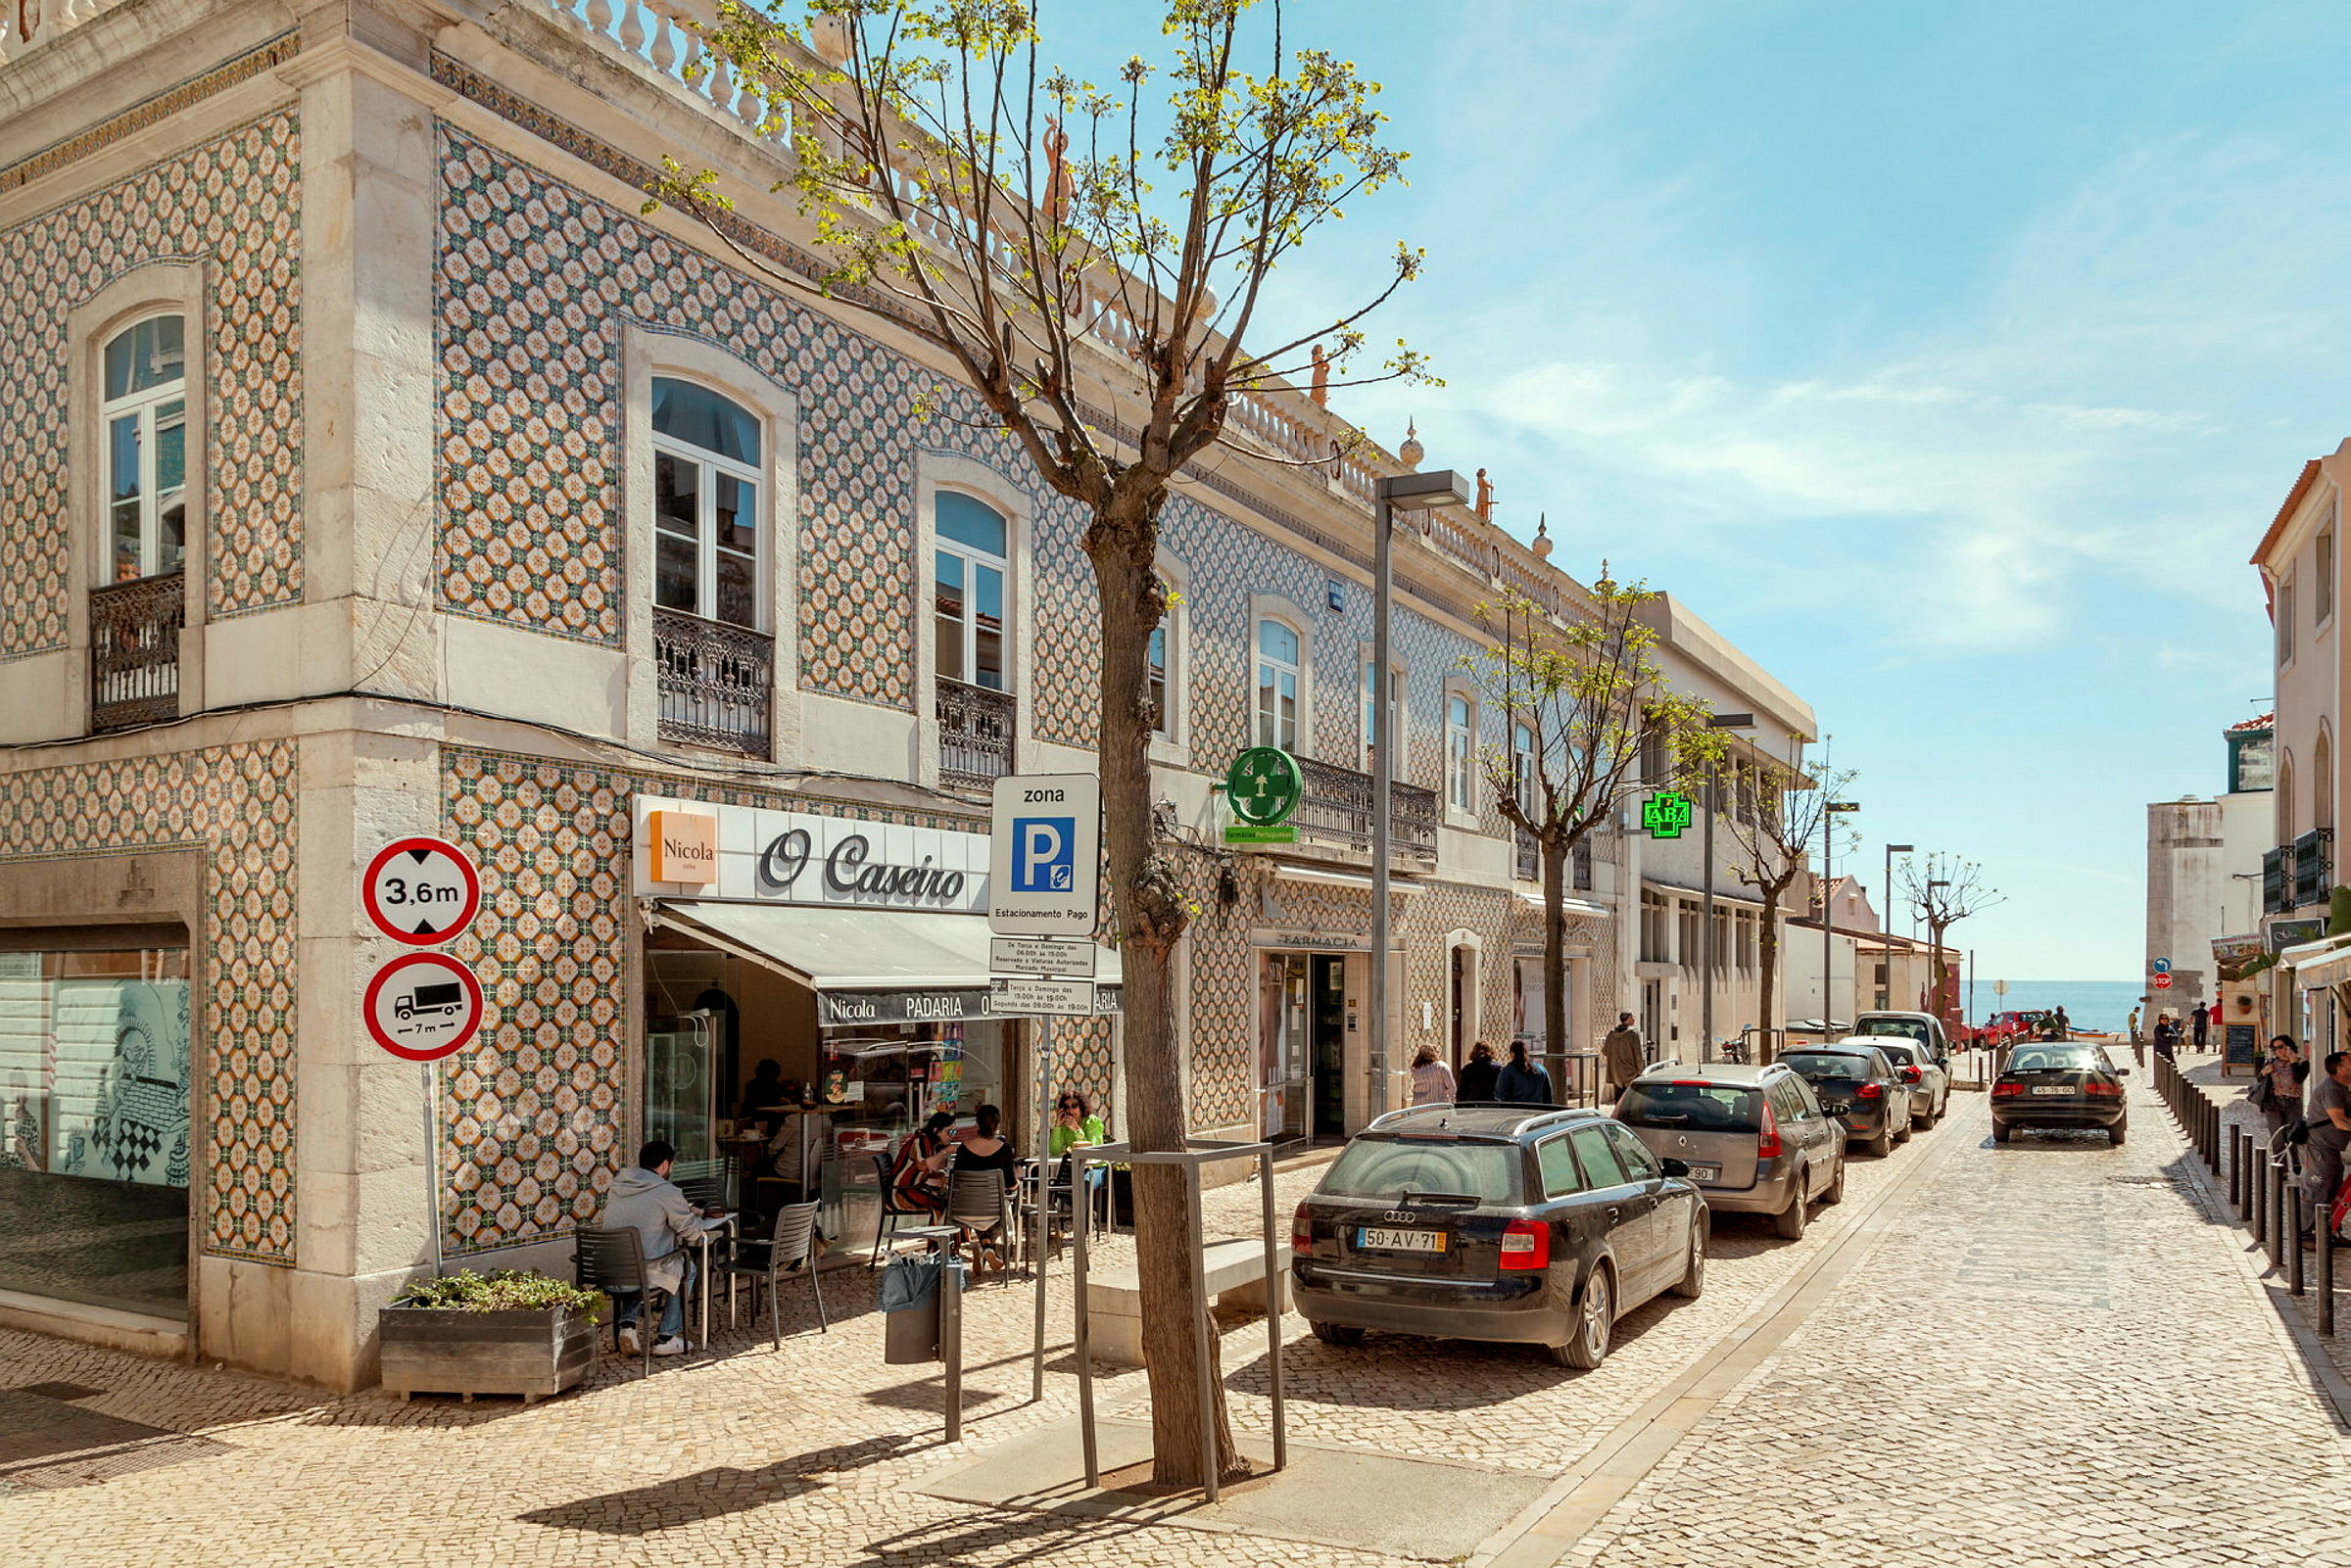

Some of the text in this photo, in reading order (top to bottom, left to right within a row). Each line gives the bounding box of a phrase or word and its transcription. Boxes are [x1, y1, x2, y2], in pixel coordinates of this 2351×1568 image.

[1024, 788, 1064, 802] zona
[664, 837, 714, 862] Nicola
[1024, 824, 1062, 885] P
[760, 829, 965, 899] O Caseiro
[995, 908, 1088, 921] Estacionamento Pago
[1056, 958, 1088, 967] Autorizadas
[830, 997, 876, 1019] Nicola
[906, 997, 963, 1018] PADARIA
[1095, 992, 1118, 1011] ARIA
